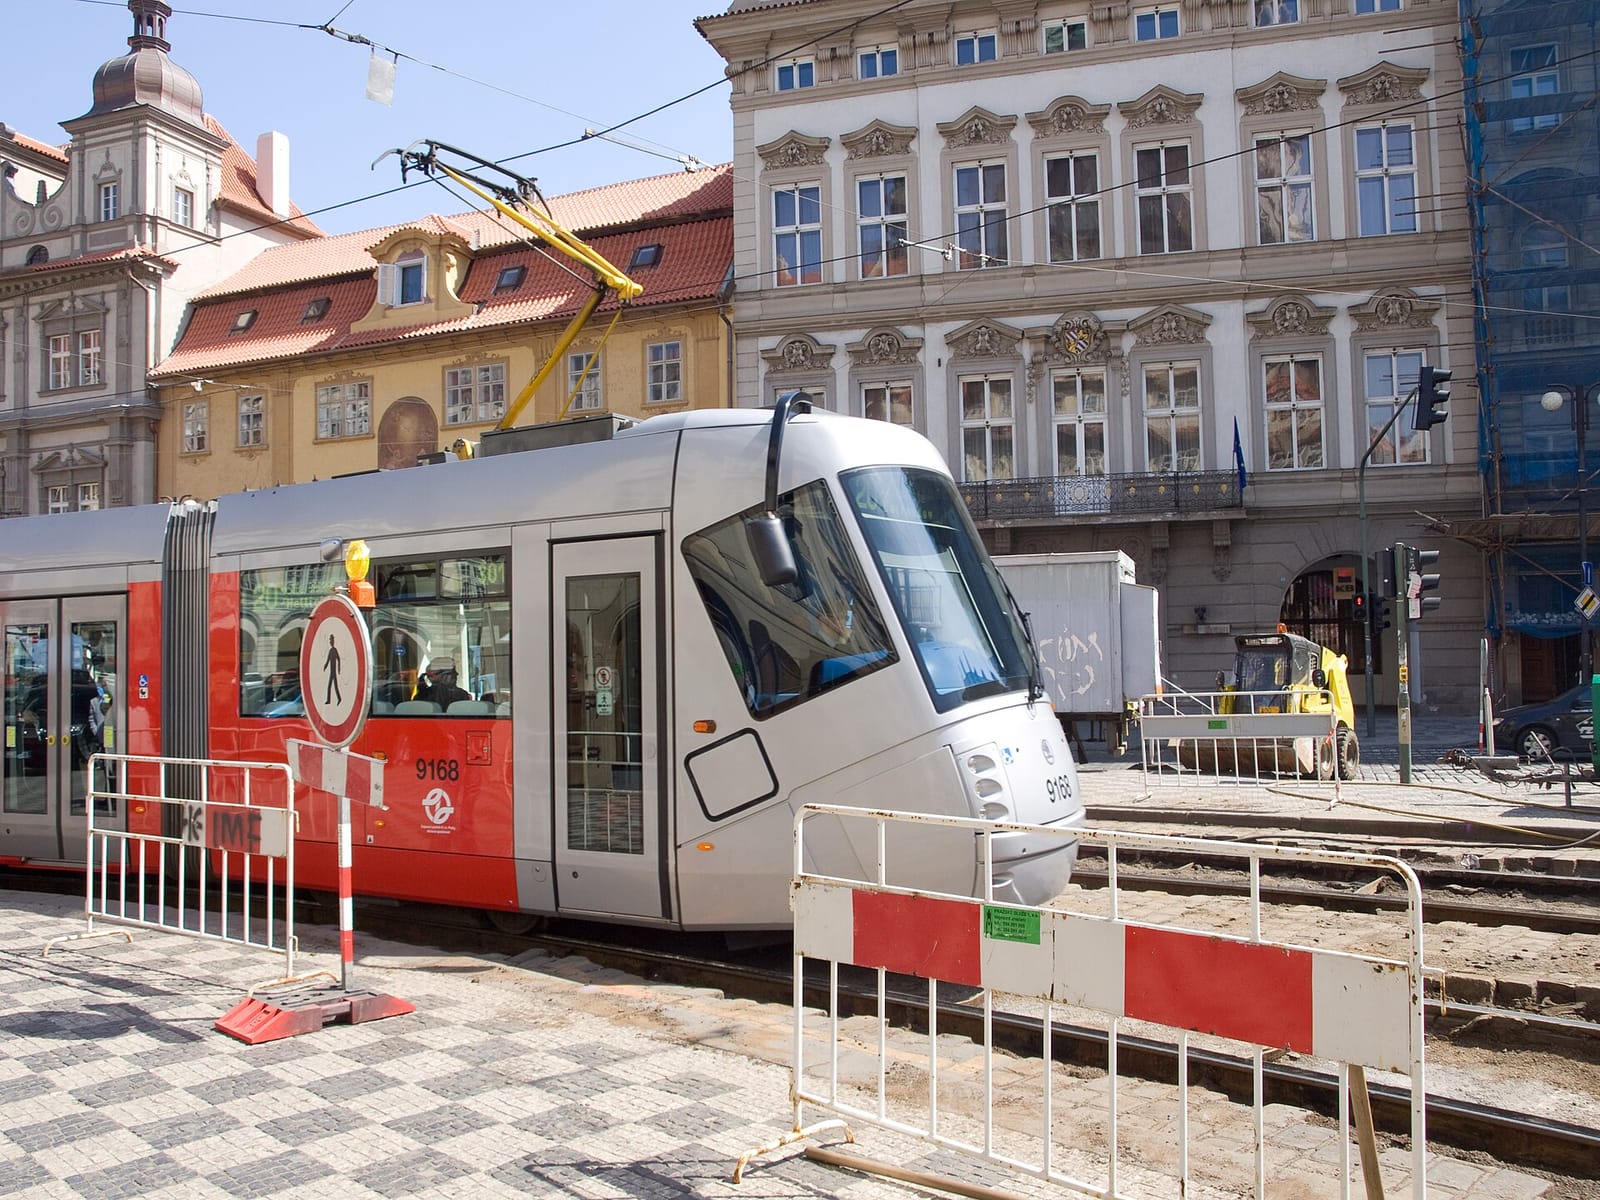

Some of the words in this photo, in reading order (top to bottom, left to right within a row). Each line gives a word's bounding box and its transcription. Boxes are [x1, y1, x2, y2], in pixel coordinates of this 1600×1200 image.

[1336, 584, 1354, 592] KB
[416, 758, 459, 781] 9168
[1046, 774, 1072, 803] 9168
